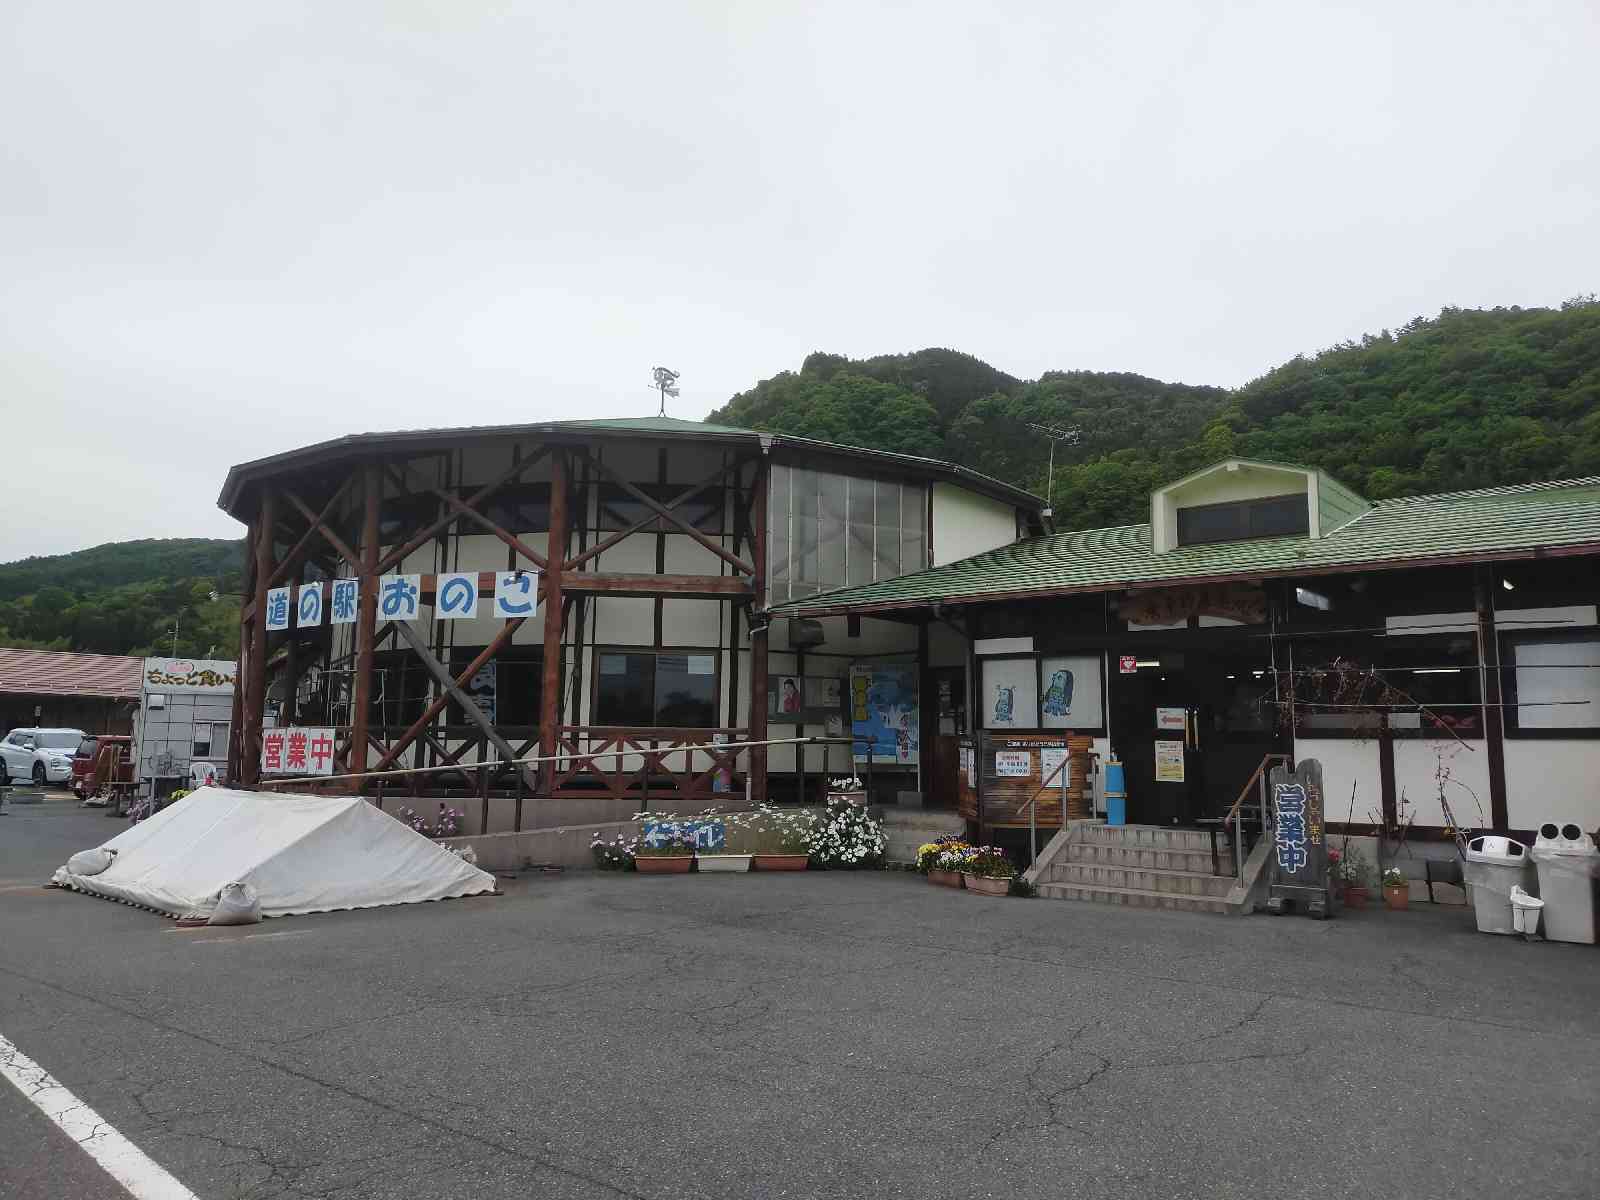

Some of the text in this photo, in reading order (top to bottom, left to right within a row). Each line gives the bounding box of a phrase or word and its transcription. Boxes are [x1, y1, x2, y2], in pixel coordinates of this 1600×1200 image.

[264, 732, 333, 770] 営業中
[1275, 783, 1306, 874] 営業中
